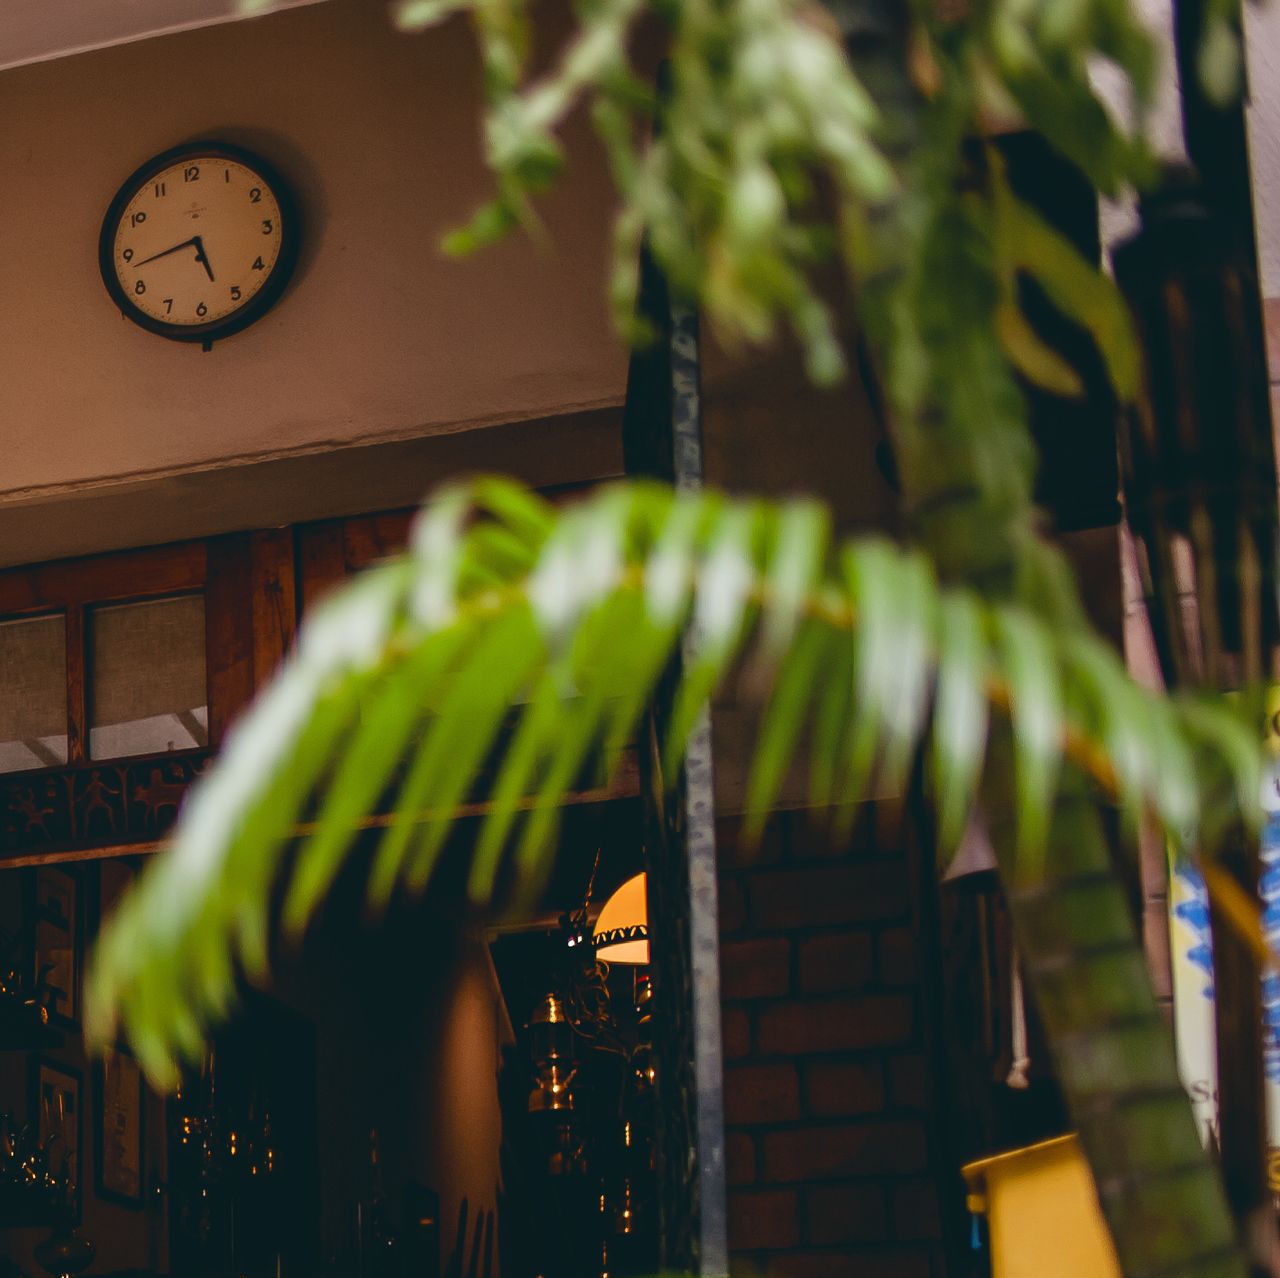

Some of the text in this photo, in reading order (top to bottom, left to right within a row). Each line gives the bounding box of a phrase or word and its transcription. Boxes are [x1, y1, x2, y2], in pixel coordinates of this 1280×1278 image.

[184, 166, 200, 183] 12
[154, 182, 166, 198] 11
[249, 187, 262, 204] 2
[131, 211, 147, 229] 10
[261, 219, 273, 235] 3
[122, 248, 134, 264] 9
[251, 255, 266, 272] 4
[134, 279, 146, 296] 8
[230, 285, 242, 302] 5
[162, 298, 174, 315] 7
[195, 301, 208, 318] 6
